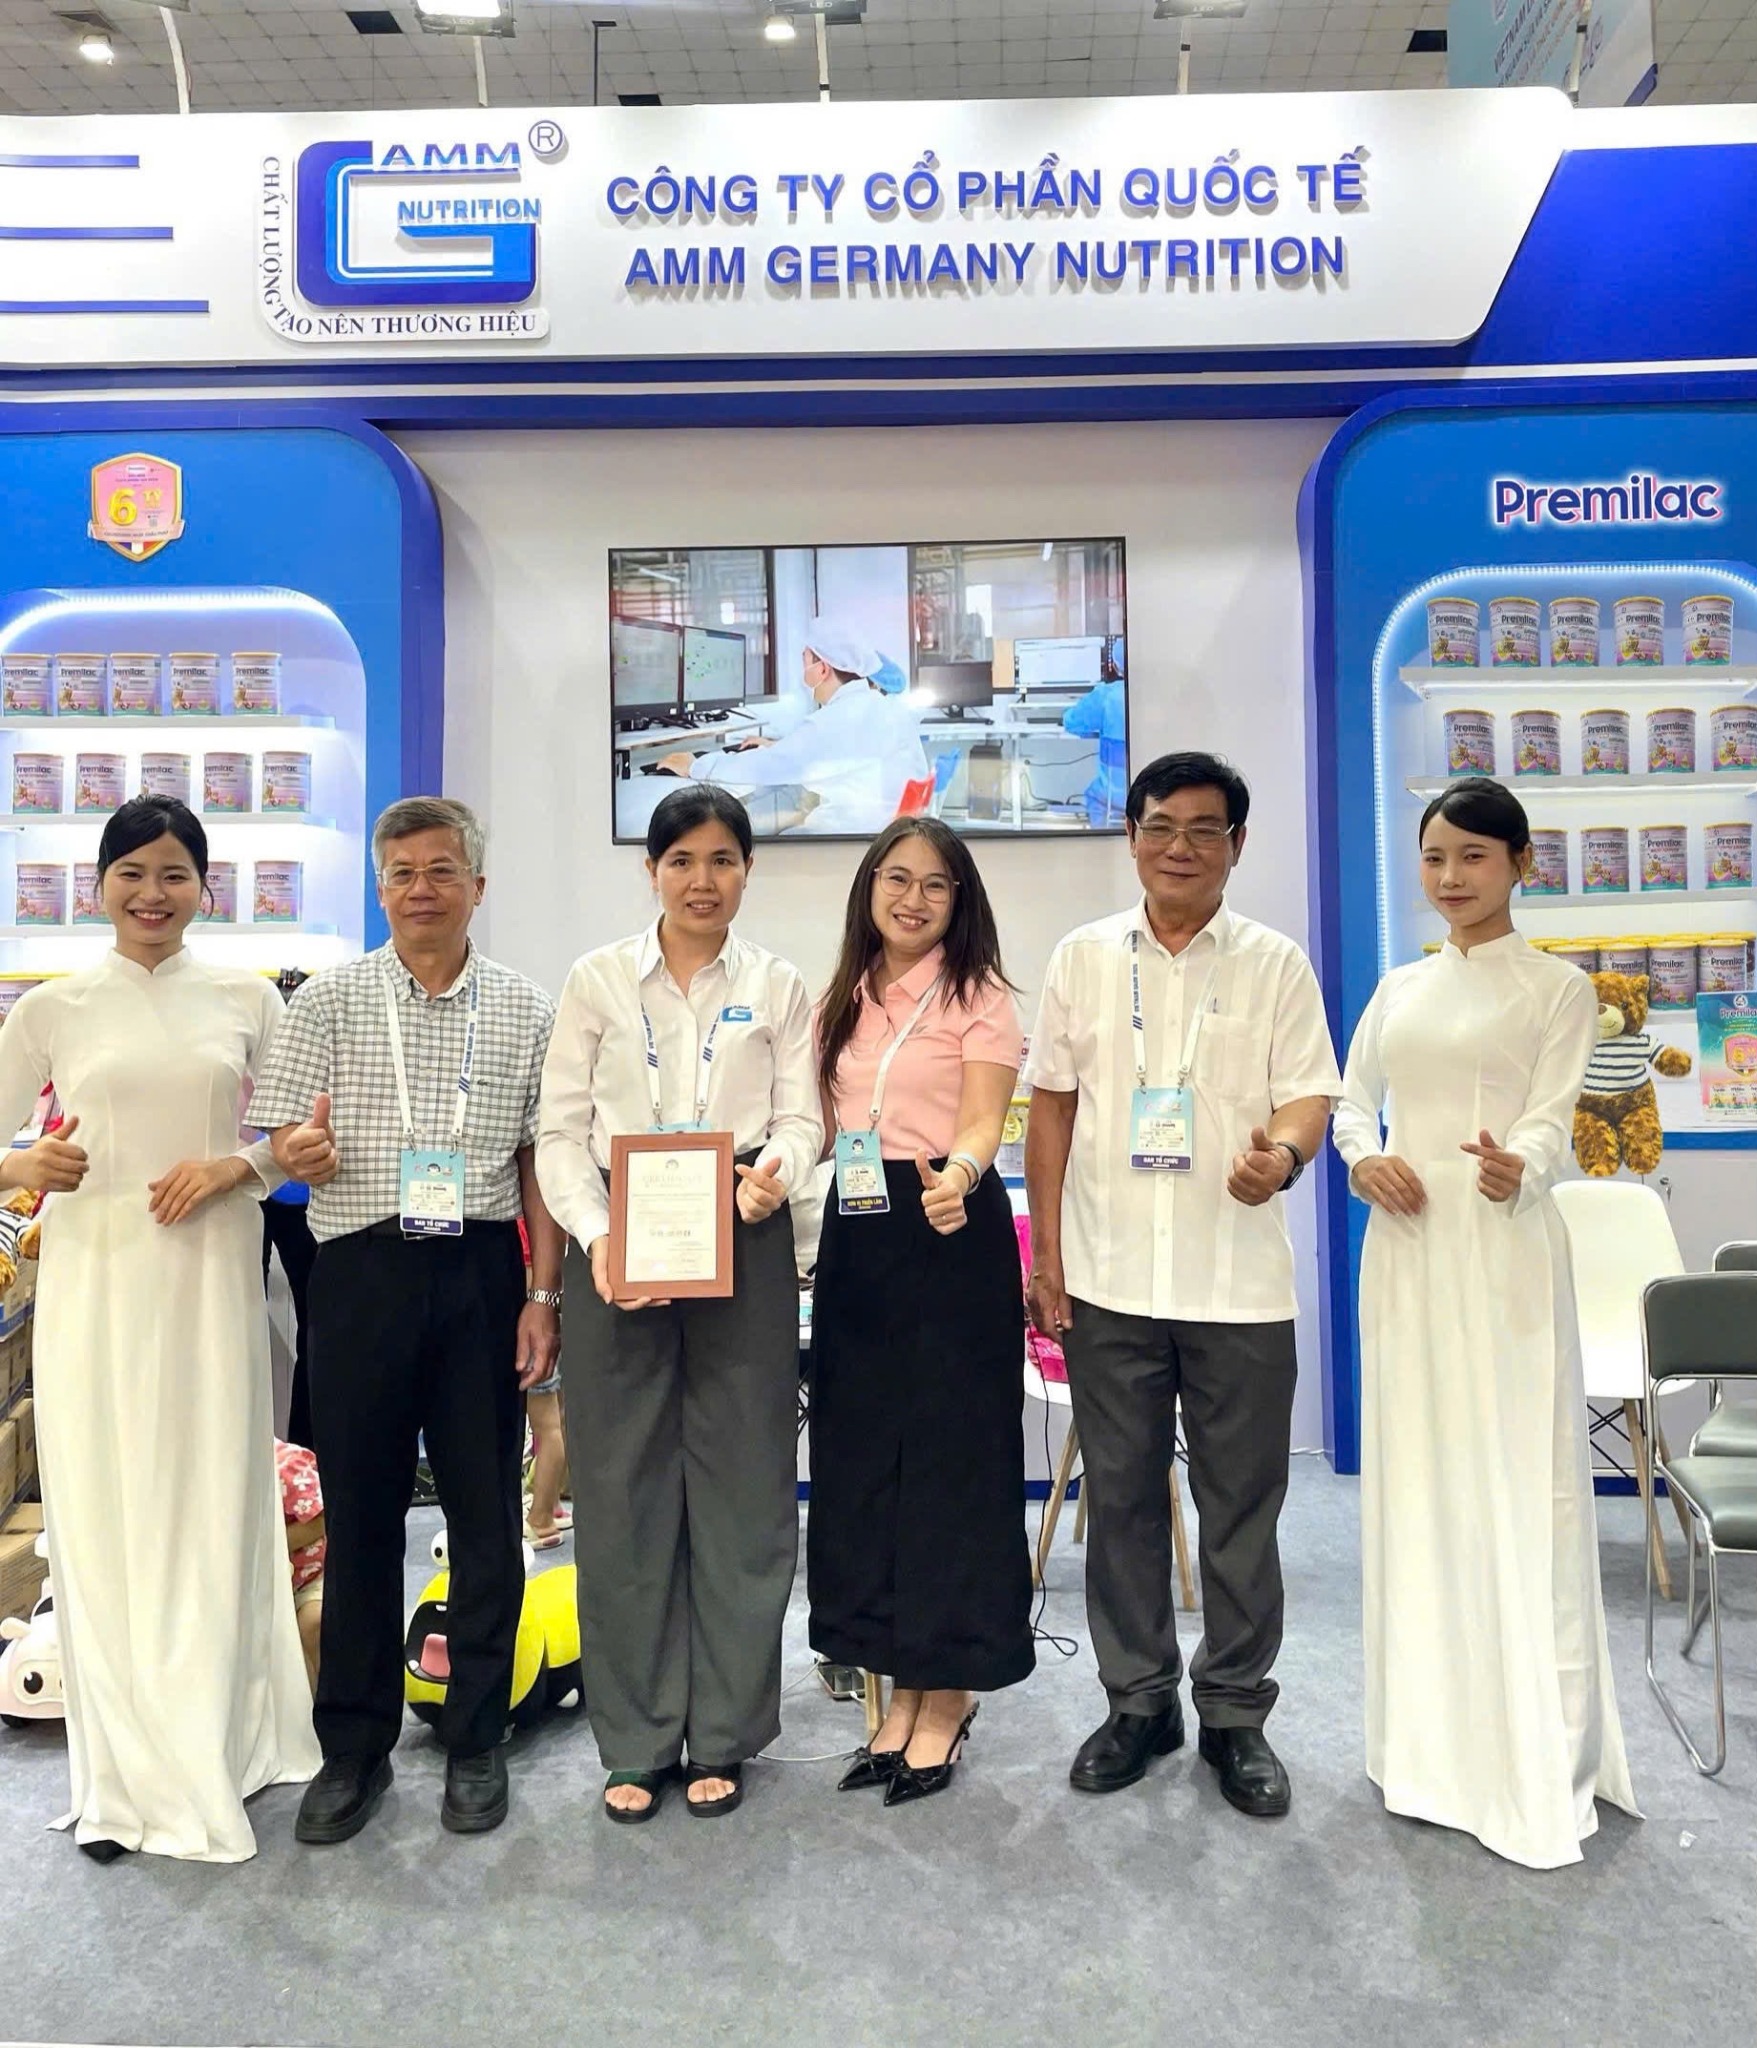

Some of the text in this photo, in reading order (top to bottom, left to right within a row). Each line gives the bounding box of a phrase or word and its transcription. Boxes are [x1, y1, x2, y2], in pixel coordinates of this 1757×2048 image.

[379, 142, 521, 166] AMM
[607, 145, 1366, 216] CÔNG TY CỔ PHẦN QUỐC TẾ
[398, 197, 540, 223] NUTRITION
[259, 156, 536, 337] CHẤT LƯỢNG TẠO NÊN THƯƠNG HIỆU
[625, 236, 1343, 287] AMM GERMANY NUTRITION
[108, 487, 137, 526] 6
[1494, 475, 1720, 524] Premilac
[1724, 720, 1757, 731] Premila
[1533, 842, 1561, 851] emilac
[1720, 1007, 1757, 1019] Premila
